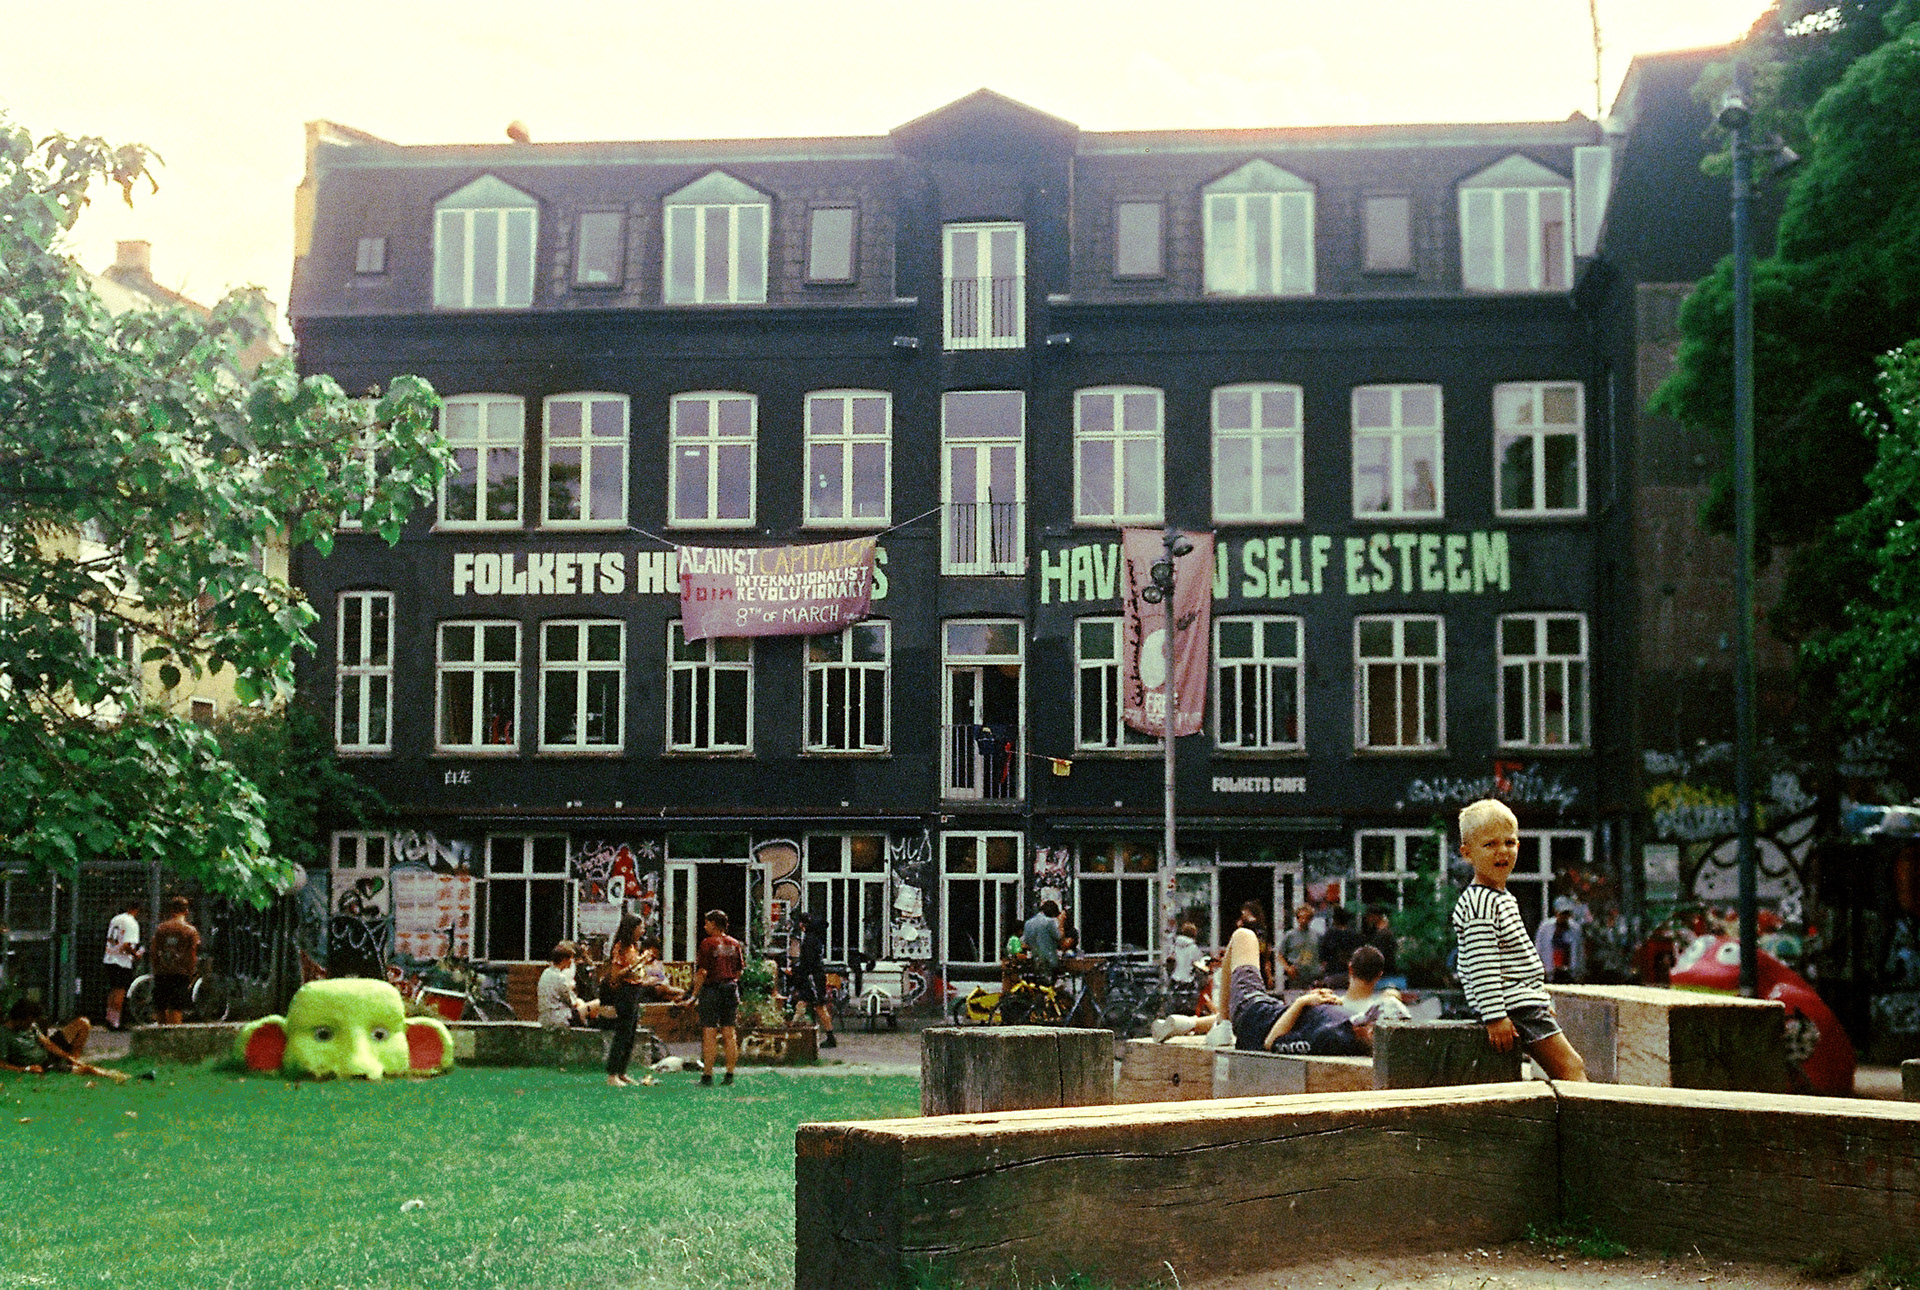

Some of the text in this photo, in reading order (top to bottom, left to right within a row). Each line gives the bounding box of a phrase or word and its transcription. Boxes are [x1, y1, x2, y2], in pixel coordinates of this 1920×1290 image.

[679, 548, 758, 575] AGAINST
[1041, 543, 1126, 604] HAV
[1242, 534, 1332, 599] SELF
[1345, 531, 1511, 595] ESTEEM
[453, 552, 626, 596] FOLKETS
[736, 565, 869, 588] INTERNATIONALIST
[736, 580, 866, 602] REVOLUTIONARY
[782, 604, 840, 624] MARCH
[1212, 776, 1271, 793] FOLKETS
